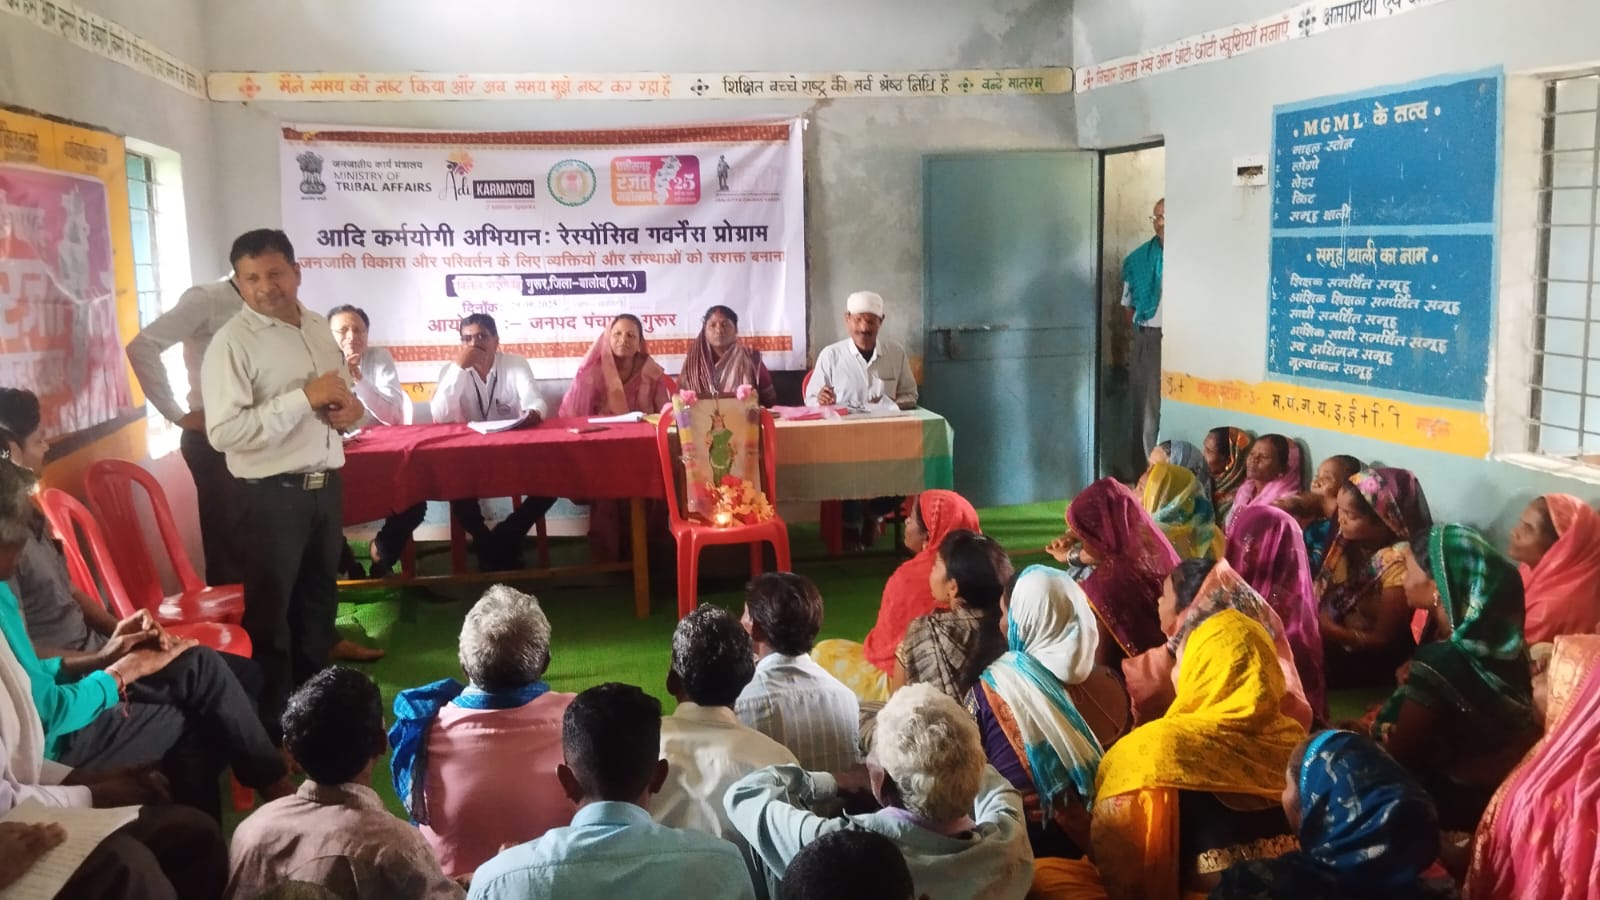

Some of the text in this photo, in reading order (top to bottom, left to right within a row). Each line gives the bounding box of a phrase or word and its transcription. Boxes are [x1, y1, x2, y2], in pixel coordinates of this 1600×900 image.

[311, 79, 345, 94] समय
[375, 80, 403, 94] नष्ट
[411, 76, 445, 94] किया
[484, 80, 507, 94] अब
[515, 79, 546, 94] समय
[578, 80, 603, 94] नष्ट
[611, 80, 632, 93] कर
[723, 75, 764, 95] शिक्षित
[831, 74, 847, 92] की
[854, 74, 872, 92] सर्व
[908, 74, 936, 92] निधि
[1304, 101, 1428, 136] MGML के तत्व
[1326, 134, 1355, 152] स्टोन
[333, 159, 372, 170] जनजातीय
[375, 158, 392, 169] कार्य
[334, 172, 401, 181] MINISTRY OF
[674, 173, 696, 190] 25
[336, 182, 432, 193] TRIBAL AFFAIRS
[477, 182, 534, 197] KARMAYOGI
[1289, 209, 1320, 223] समूह
[317, 223, 366, 247] आदि
[372, 223, 454, 247] कर्मयोगी
[557, 222, 639, 245] रेस्पोंसिव
[712, 219, 768, 243] प्रोग्राम
[298, 248, 784, 270] जनजाति विकास और परिवर्तन के लिए व्यक्तियों और संस्थाओं को सशक्त बनाना
[1316, 239, 1429, 268] समूह थाली का नाम
[1376, 279, 1412, 294] समूह
[1423, 300, 1461, 316] समूह
[528, 316, 577, 331] जनपद
[1364, 314, 1398, 329] समूह
[1408, 337, 1448, 355] समूह
[1361, 349, 1394, 366] समूह
[1343, 363, 1374, 380] समूह
